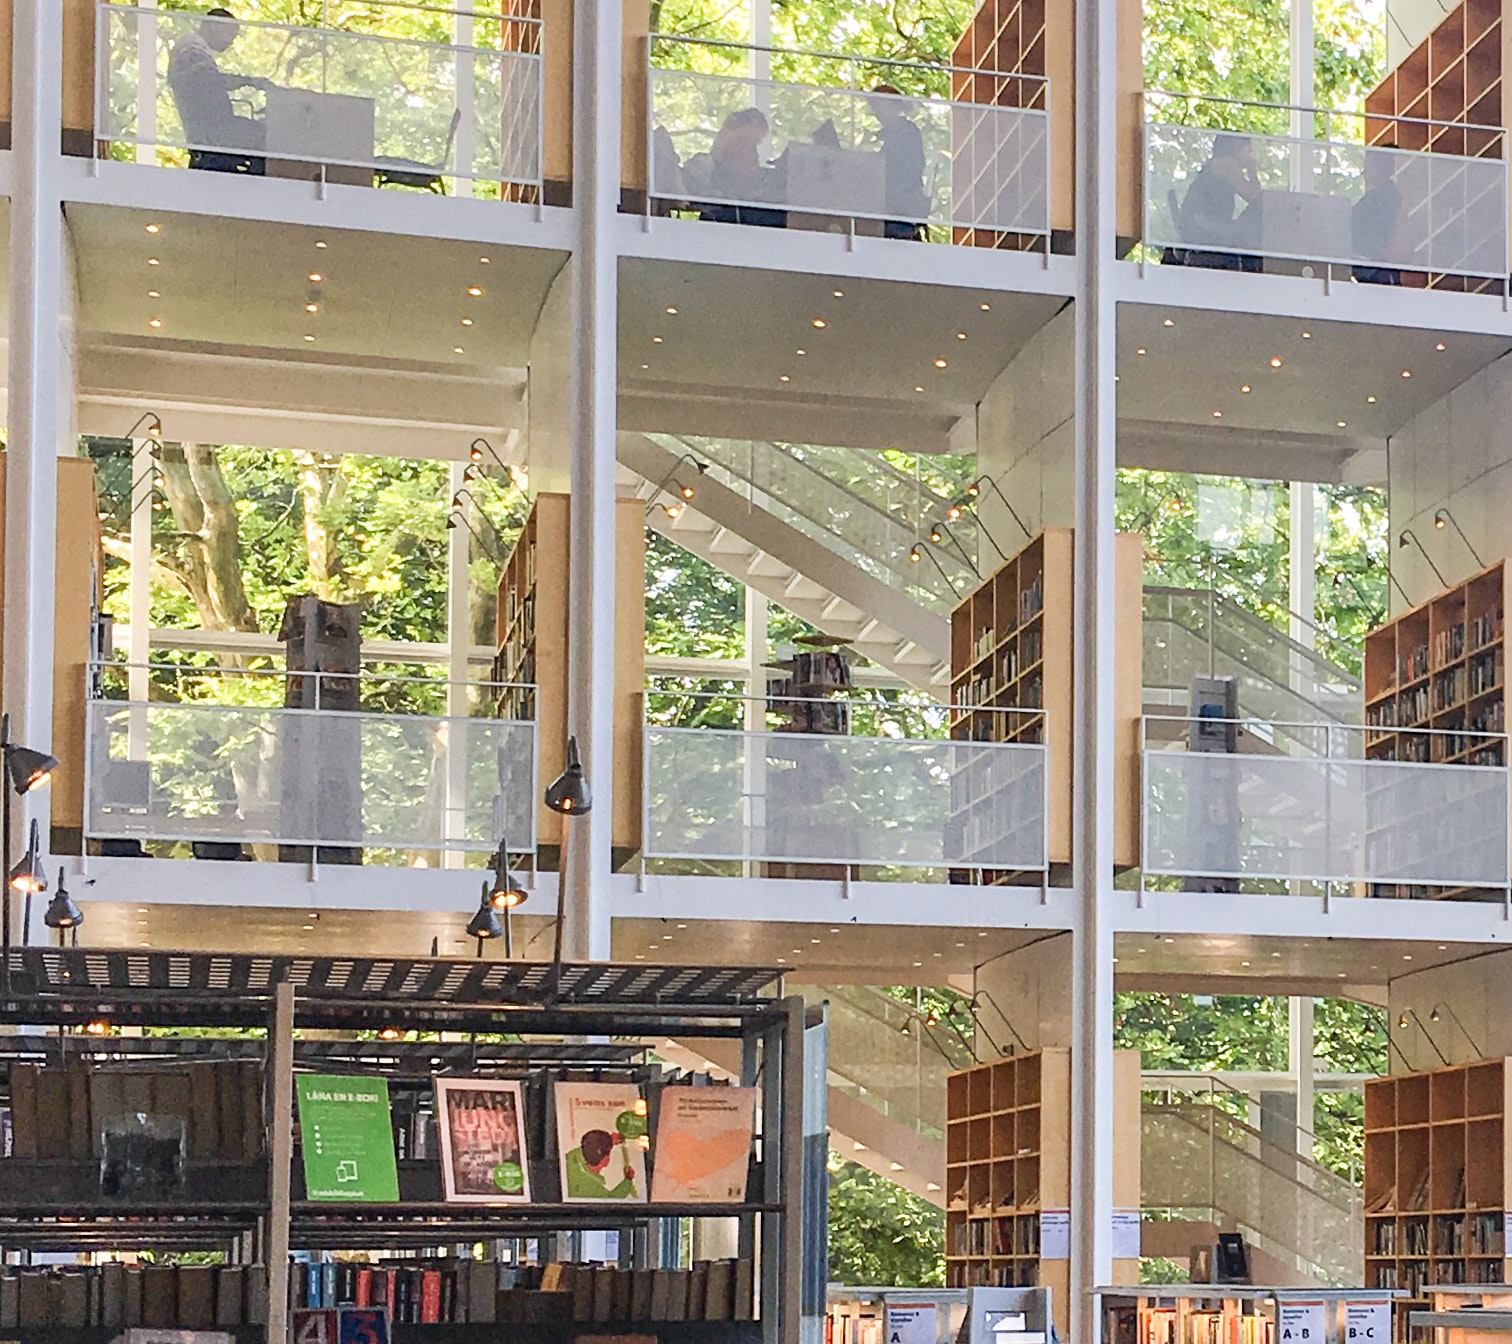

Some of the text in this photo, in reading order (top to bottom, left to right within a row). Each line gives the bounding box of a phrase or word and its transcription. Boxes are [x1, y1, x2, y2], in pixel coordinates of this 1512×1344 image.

[305, 1088, 333, 1101] LÅNA
[890, 1331, 901, 1343] A
[1282, 1328, 1292, 1339] A
[1301, 1328, 1310, 1339] B
[1348, 1327, 1357, 1338] B
[1366, 1327, 1374, 1338] C
